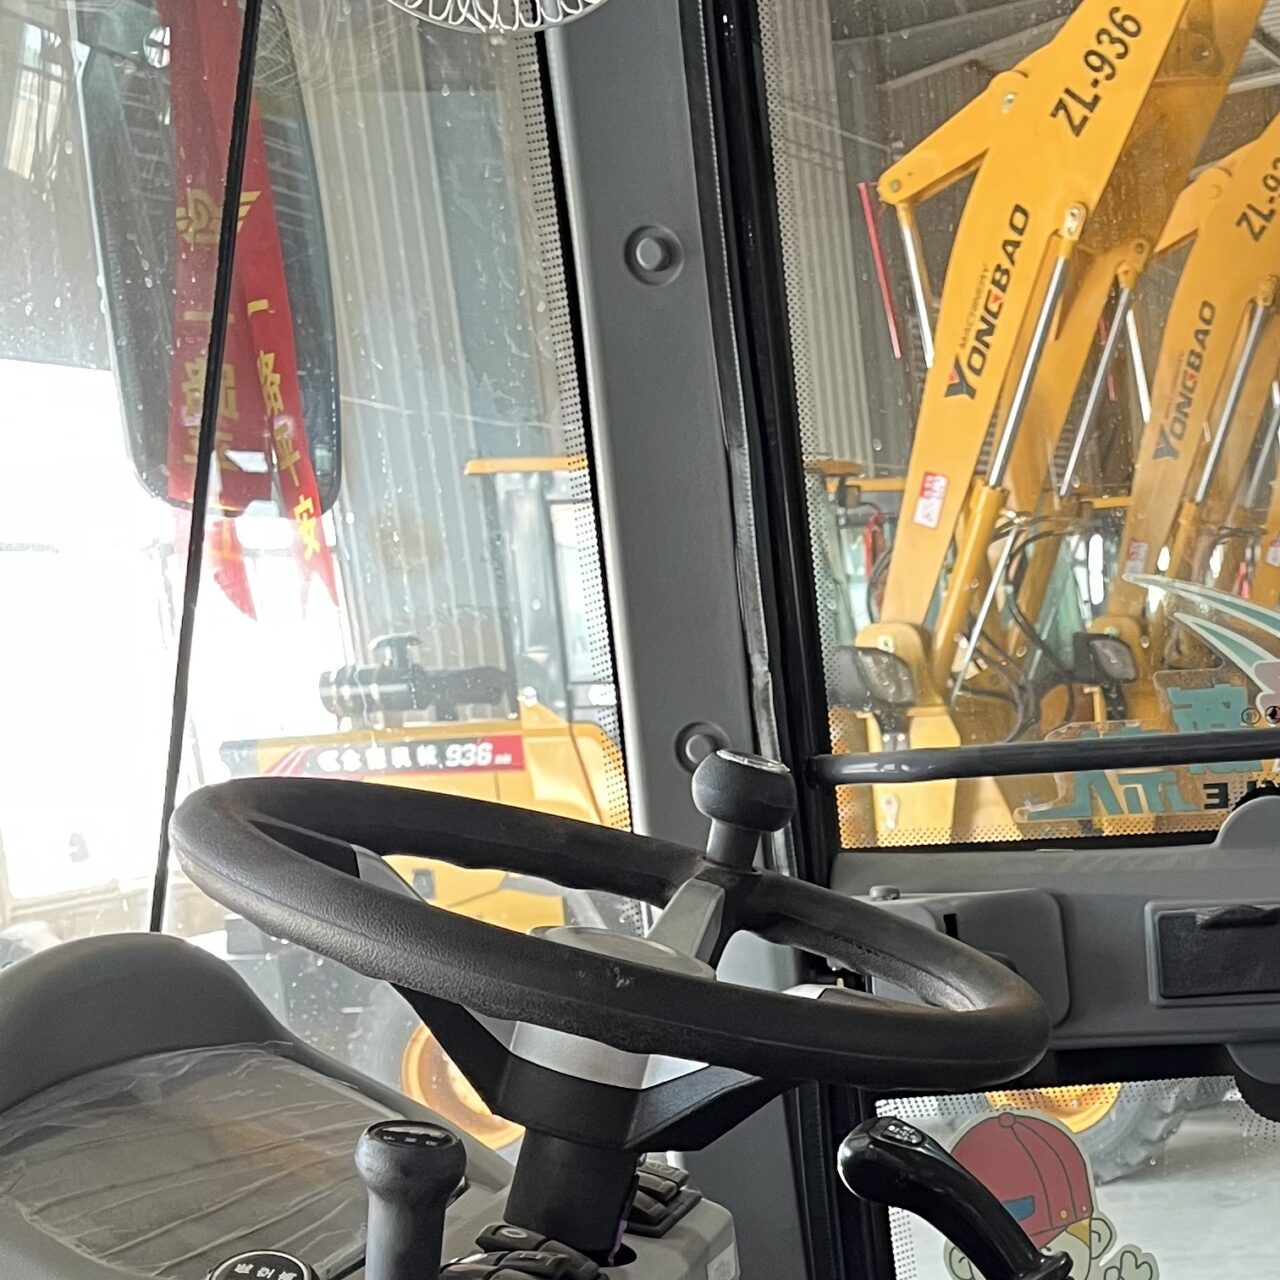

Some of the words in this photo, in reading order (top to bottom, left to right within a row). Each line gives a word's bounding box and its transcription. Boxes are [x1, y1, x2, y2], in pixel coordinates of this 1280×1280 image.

[1050, 6, 1142, 138] ZL-936
[944, 203, 1030, 401] YONGBAO
[1152, 299, 1217, 463] YONGBAO
[445, 742, 494, 768] 936
